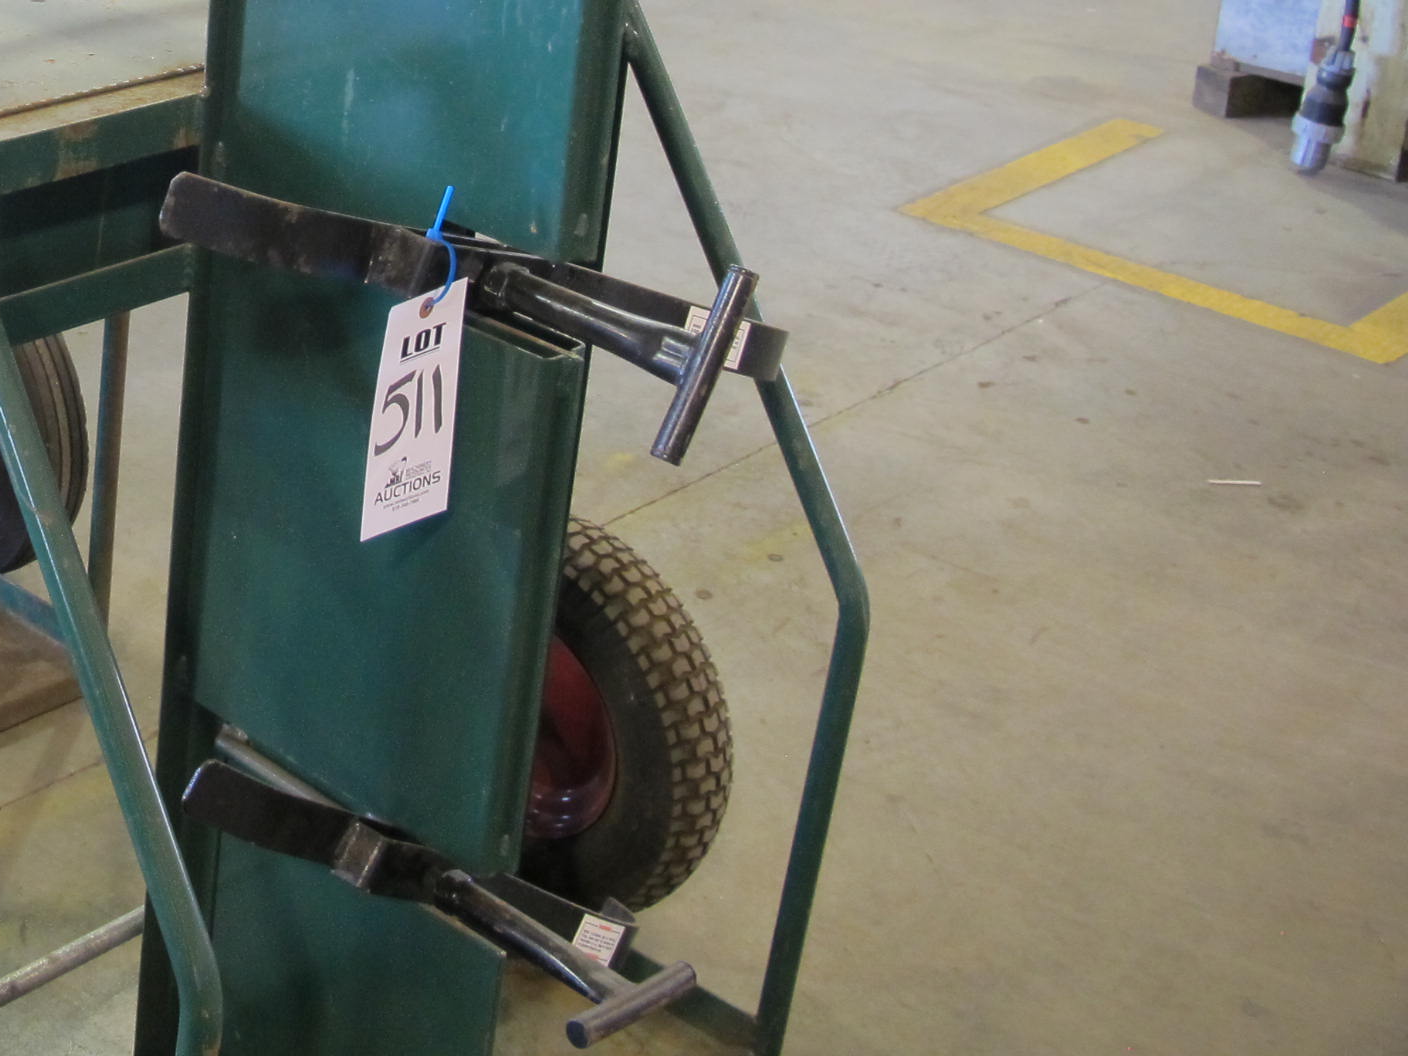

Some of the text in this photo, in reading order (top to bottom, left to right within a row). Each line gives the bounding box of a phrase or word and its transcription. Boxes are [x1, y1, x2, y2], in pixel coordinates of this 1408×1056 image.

[400, 322, 447, 359] LOT
[374, 364, 442, 456] 511
[374, 470, 441, 505] AUCTIONS
